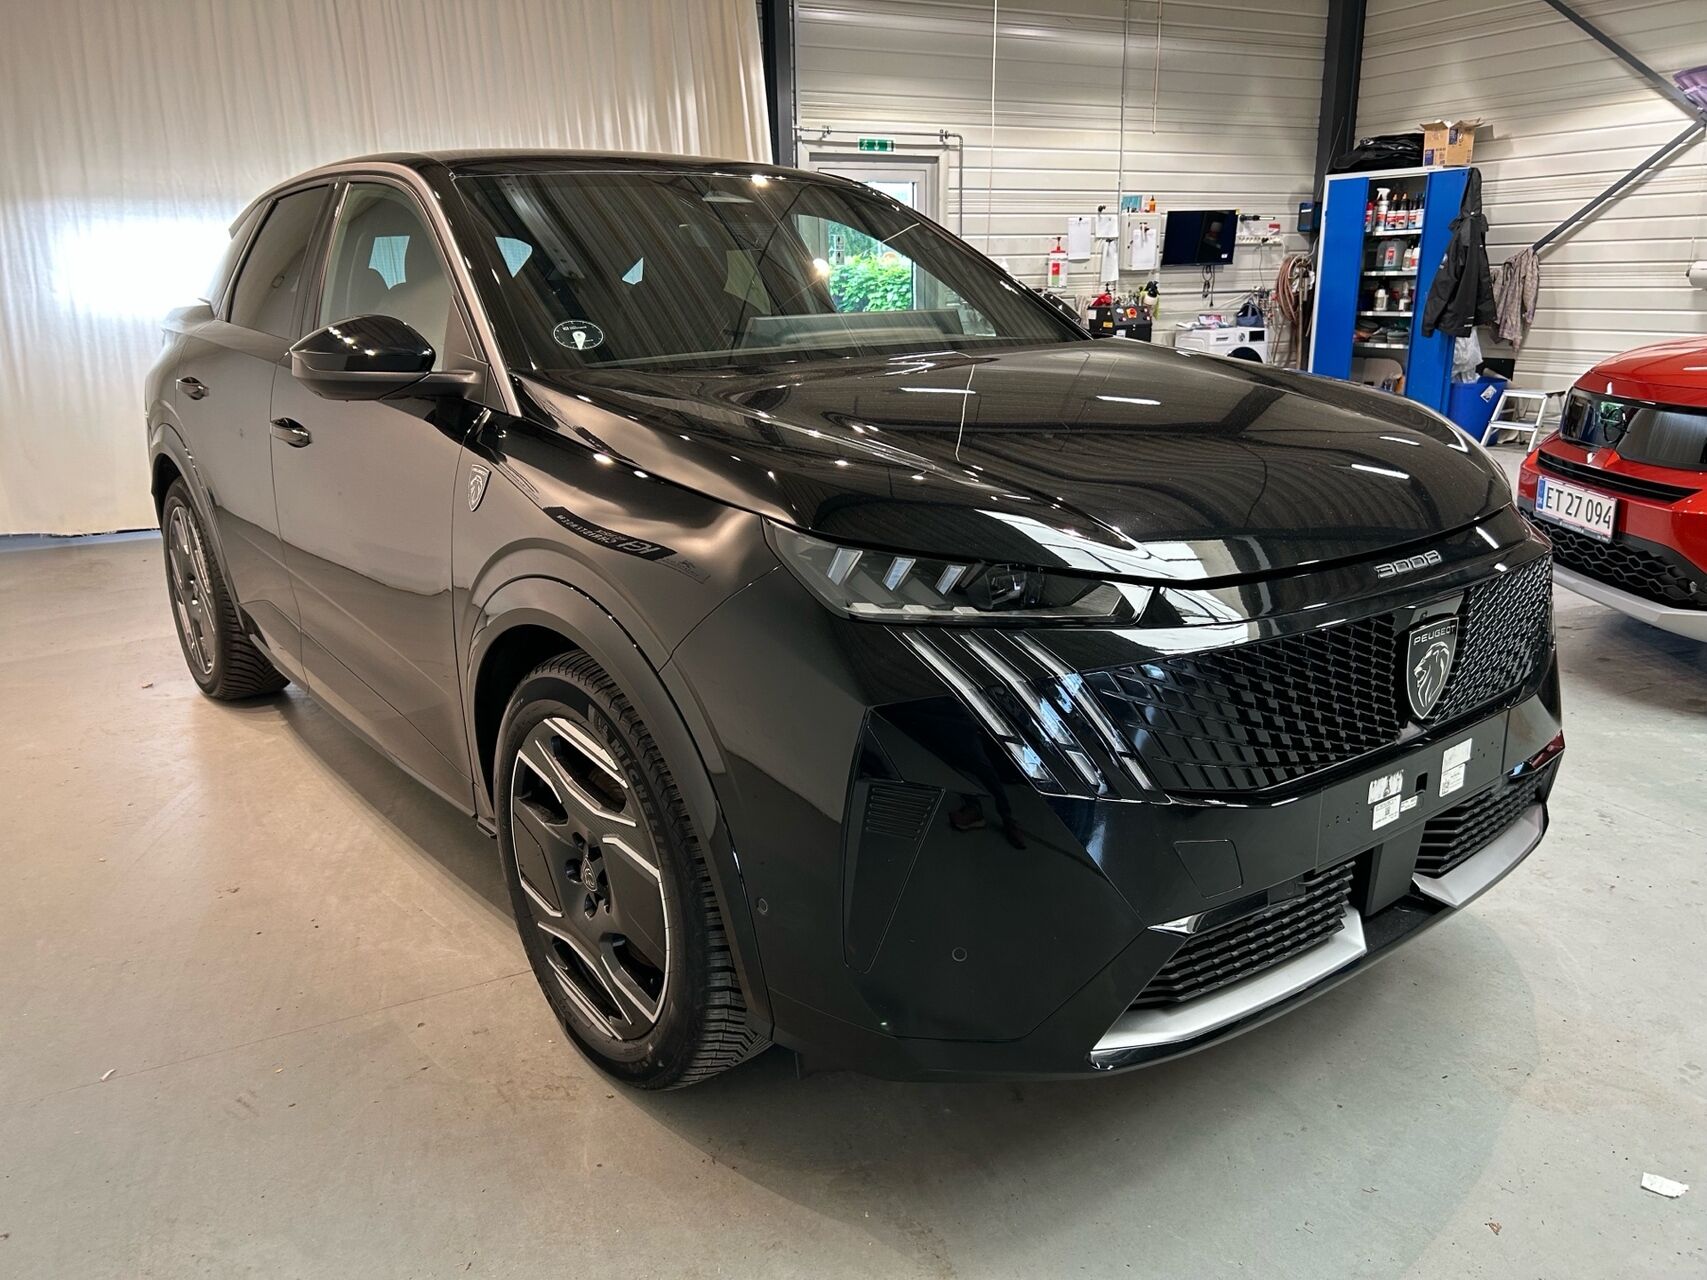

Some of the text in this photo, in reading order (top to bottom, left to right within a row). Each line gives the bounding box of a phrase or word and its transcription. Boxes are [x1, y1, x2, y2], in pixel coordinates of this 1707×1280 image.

[1546, 486, 1563, 511] ET
[1565, 492, 1582, 517] 27
[1586, 498, 1612, 529] 094
[1374, 549, 1442, 577] 3008
[1413, 624, 1456, 646] PEUGEOT
